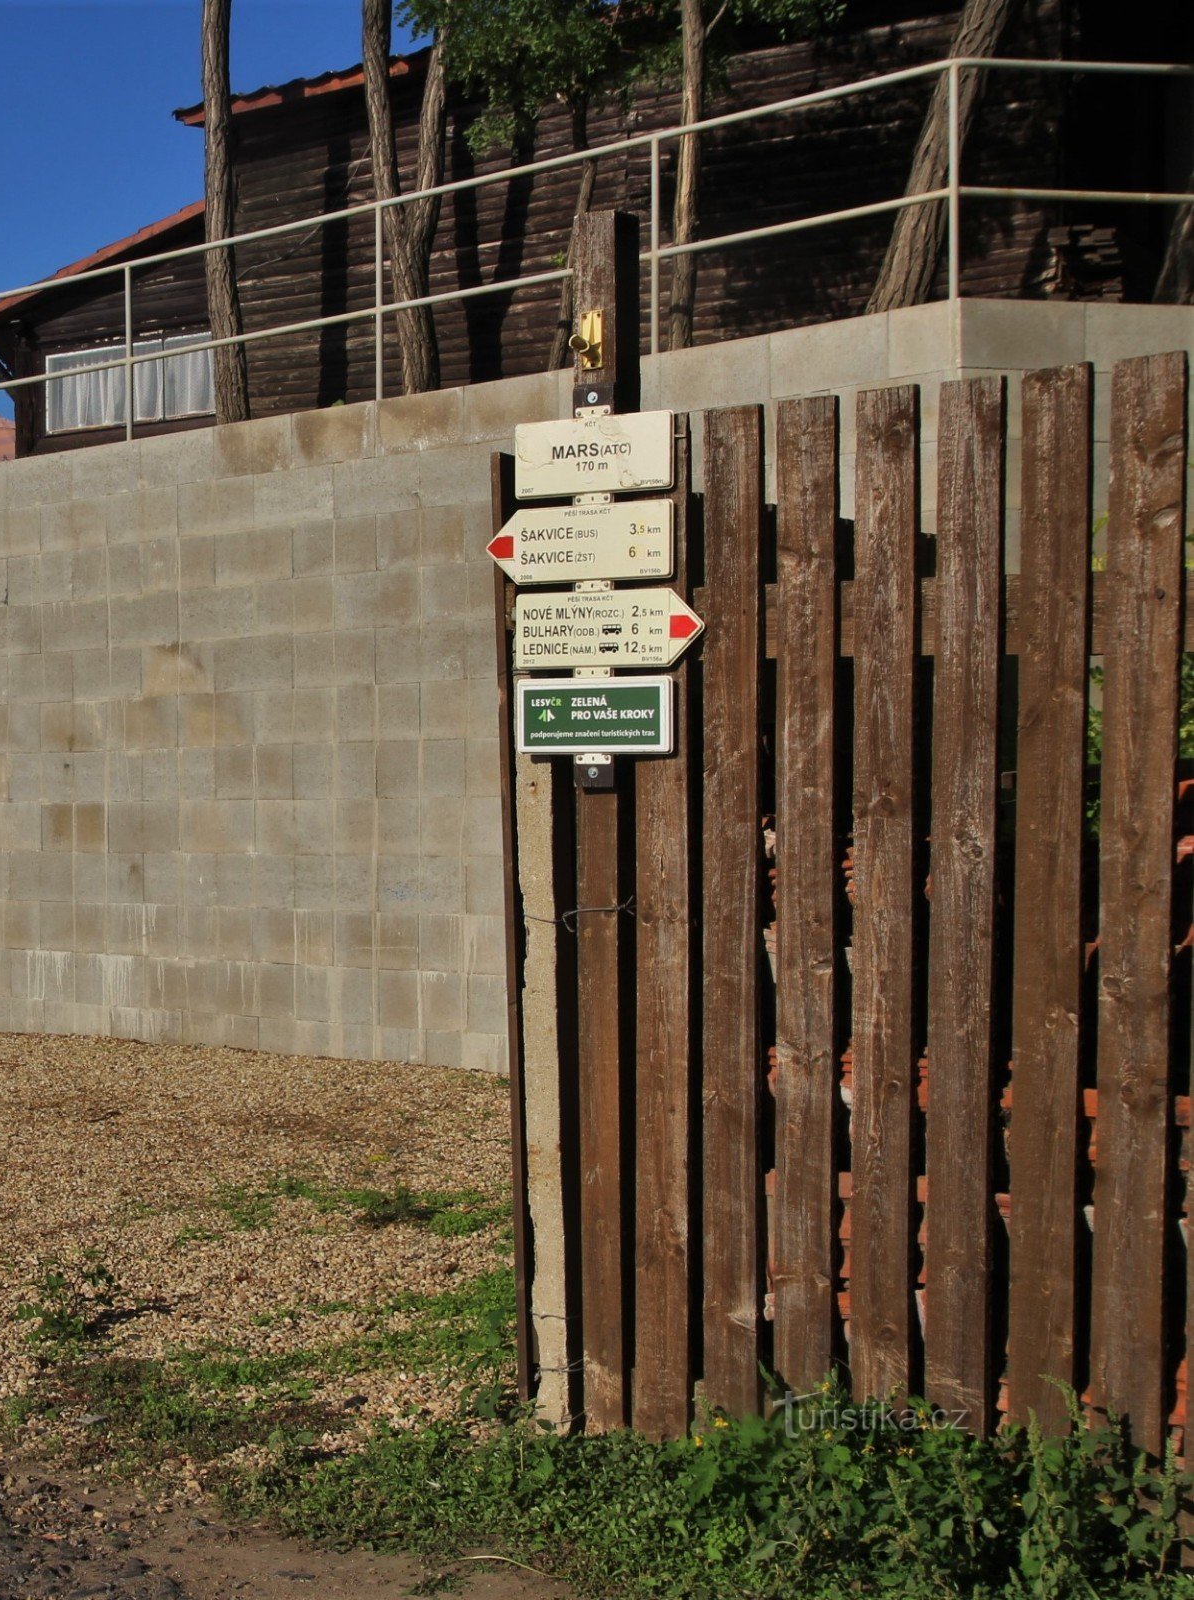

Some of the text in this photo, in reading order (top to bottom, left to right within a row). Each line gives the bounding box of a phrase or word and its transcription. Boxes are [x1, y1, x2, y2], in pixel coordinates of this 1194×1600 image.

[576, 461, 594, 471] 170
[629, 546, 636, 557] 6
[523, 606, 552, 620] NOVÉ
[632, 606, 663, 618] 2,5 km
[632, 623, 638, 635] 6
[624, 642, 662, 654] 12,5 km
[571, 694, 607, 707] ZELENÁ
[571, 708, 655, 720] PRO VAŠE KROKY
[531, 731, 573, 739] podporujeme
[601, 729, 640, 738] turistických
